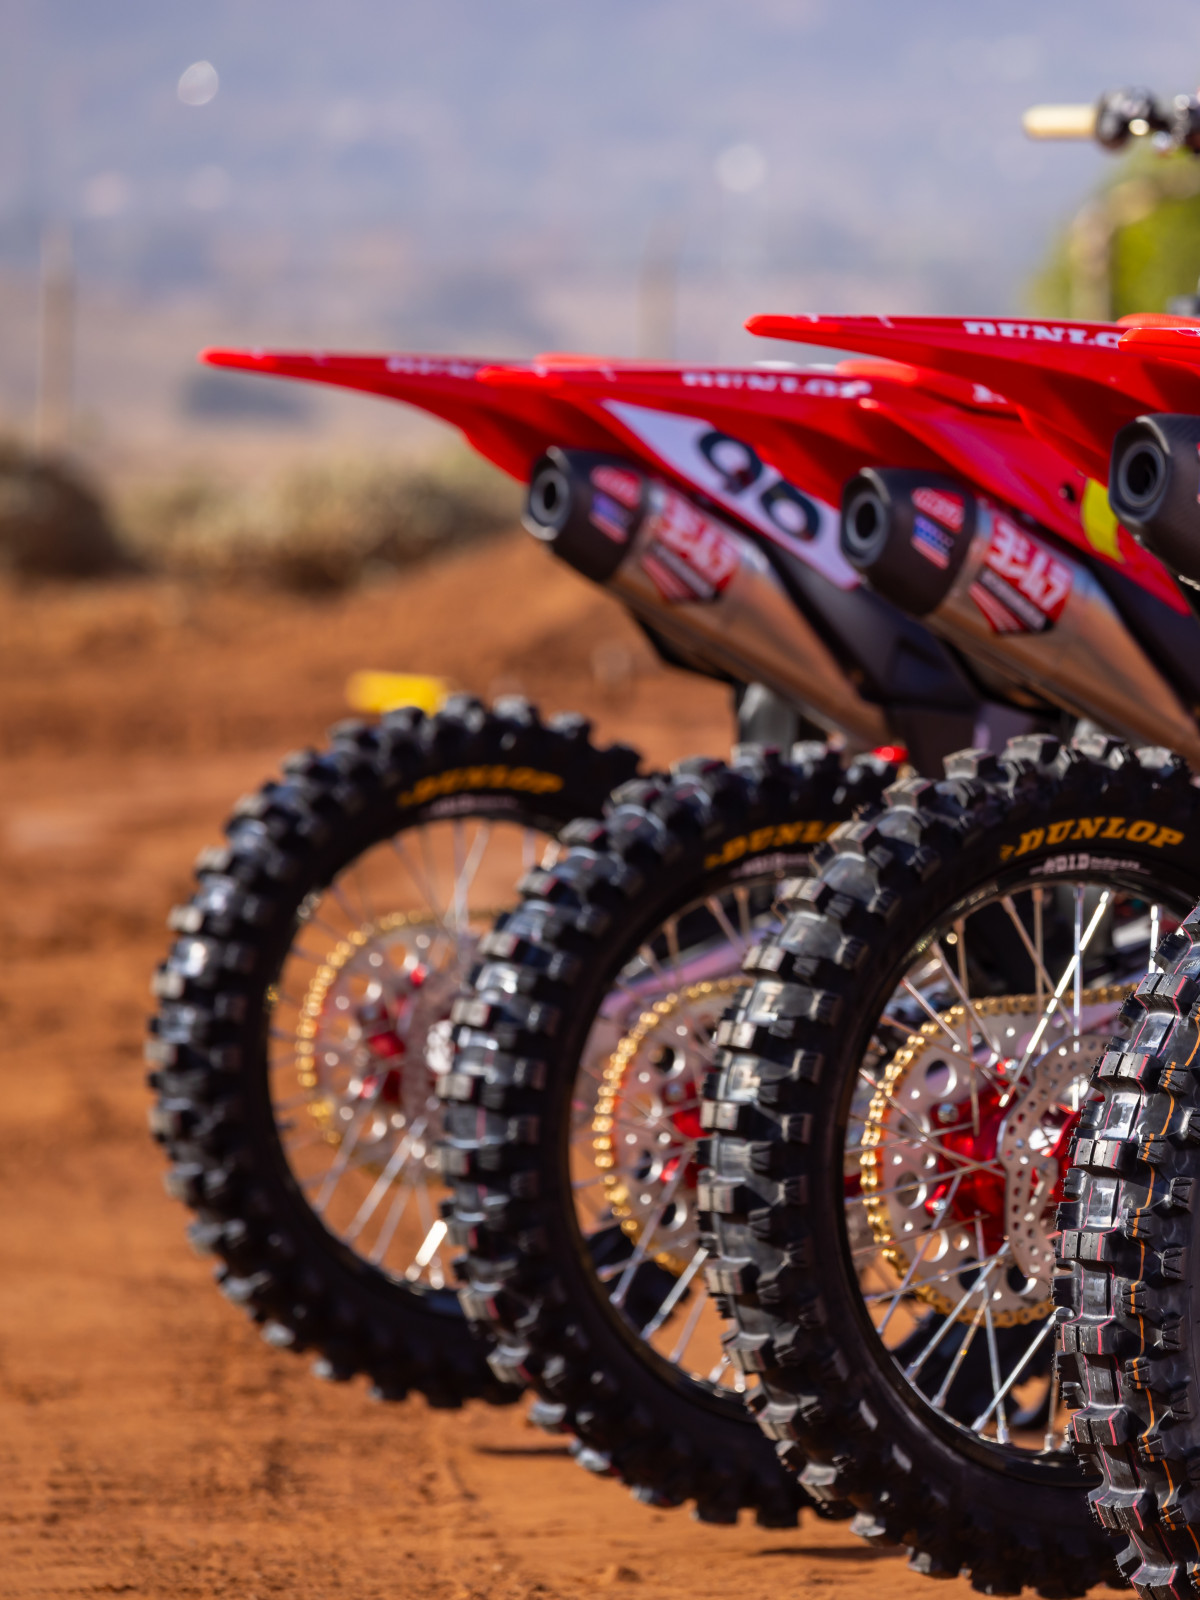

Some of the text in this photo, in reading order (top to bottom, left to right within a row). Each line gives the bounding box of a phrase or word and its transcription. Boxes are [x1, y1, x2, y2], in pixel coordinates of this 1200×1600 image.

[963, 321, 1121, 349] DUNLO
[722, 820, 842, 865] DUNL
[1014, 816, 1185, 857] DUNLOP
